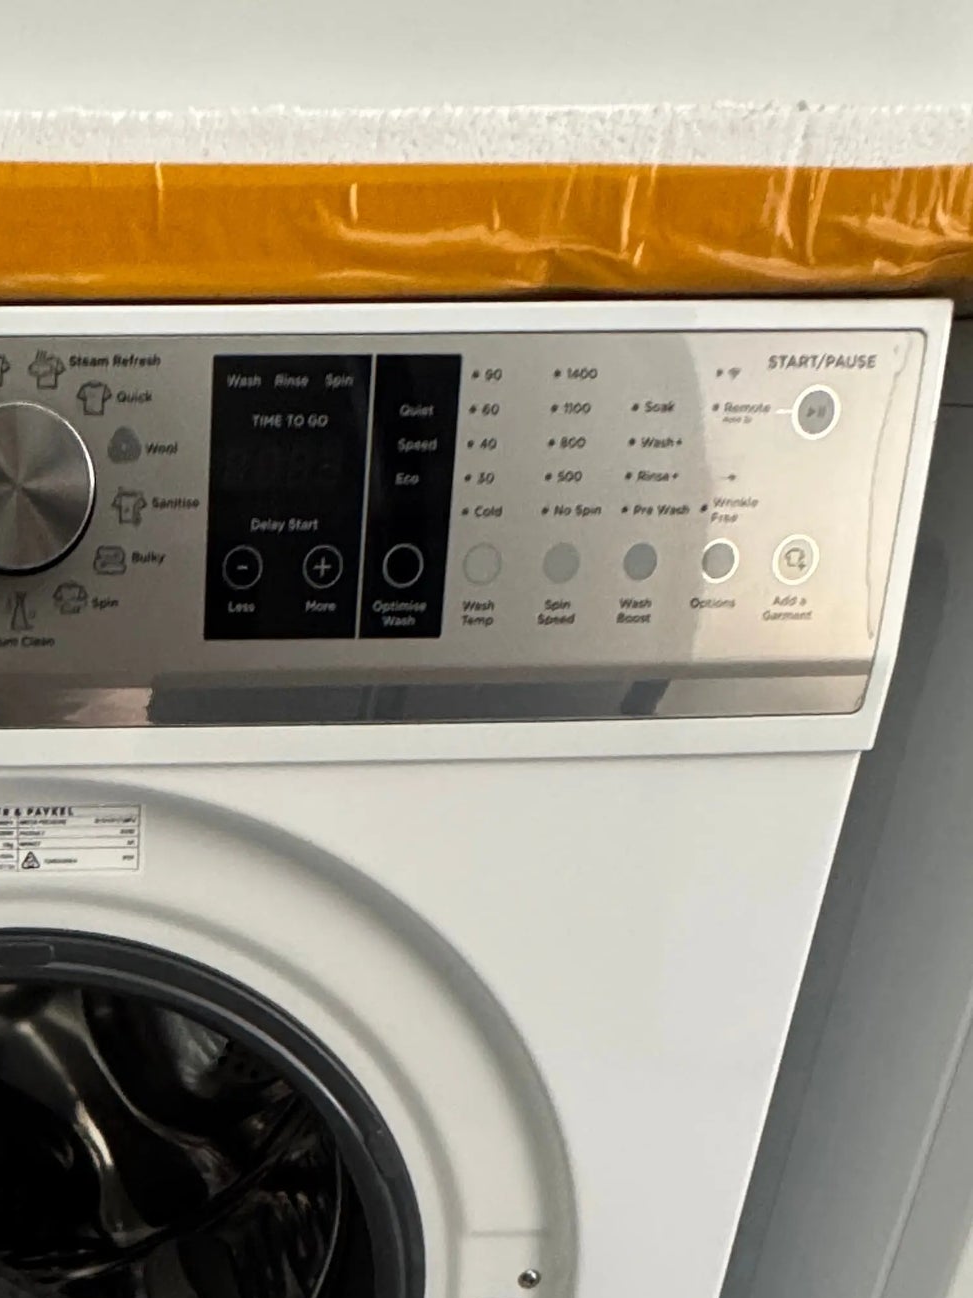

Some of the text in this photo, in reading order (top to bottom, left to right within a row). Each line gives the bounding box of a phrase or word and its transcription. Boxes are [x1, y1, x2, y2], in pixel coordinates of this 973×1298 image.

[69, 354, 161, 368] Steam Refresh
[768, 354, 878, 371] START/PAUSE
[227, 373, 355, 388] Wash Rinse Spin
[484, 368, 503, 382] 90
[567, 367, 598, 380] 1400
[116, 390, 153, 405] Quick
[399, 403, 435, 417] Quiet
[481, 403, 500, 416] 60
[563, 402, 592, 415] 1100
[644, 400, 675, 414] Soak
[724, 402, 771, 413] Remote
[252, 413, 329, 428] TIME TO GO
[145, 442, 178, 455] Wool
[398, 438, 438, 454] Speed
[479, 437, 498, 451] 40
[395, 472, 419, 486] Eco
[151, 497, 200, 511] Sanitise
[713, 496, 759, 508] Wrinkle
[474, 504, 503, 519] Cold
[554, 504, 602, 520] No Spin
[633, 504, 691, 517] Pre Wash
[711, 512, 738, 524] Free
[250, 518, 319, 533] Delay Start
[131, 551, 166, 566] Bulky
[91, 596, 119, 611] Spin
[228, 601, 255, 613] Less
[305, 600, 337, 613] More
[373, 599, 427, 614] Optimise
[462, 599, 495, 612] Wash
[544, 598, 571, 612] Spin
[620, 597, 652, 610] Wash
[690, 596, 736, 611] Options
[773, 595, 797, 607] Add
[382, 613, 416, 626] Wash
[461, 614, 494, 628] Temp
[537, 613, 575, 627] Speed
[616, 613, 651, 625] Boost
[763, 610, 812, 623] Garment
[21, 636, 55, 648] Clean
[14, 808, 21, 816] &
[27, 806, 74, 816] PAYKEL
